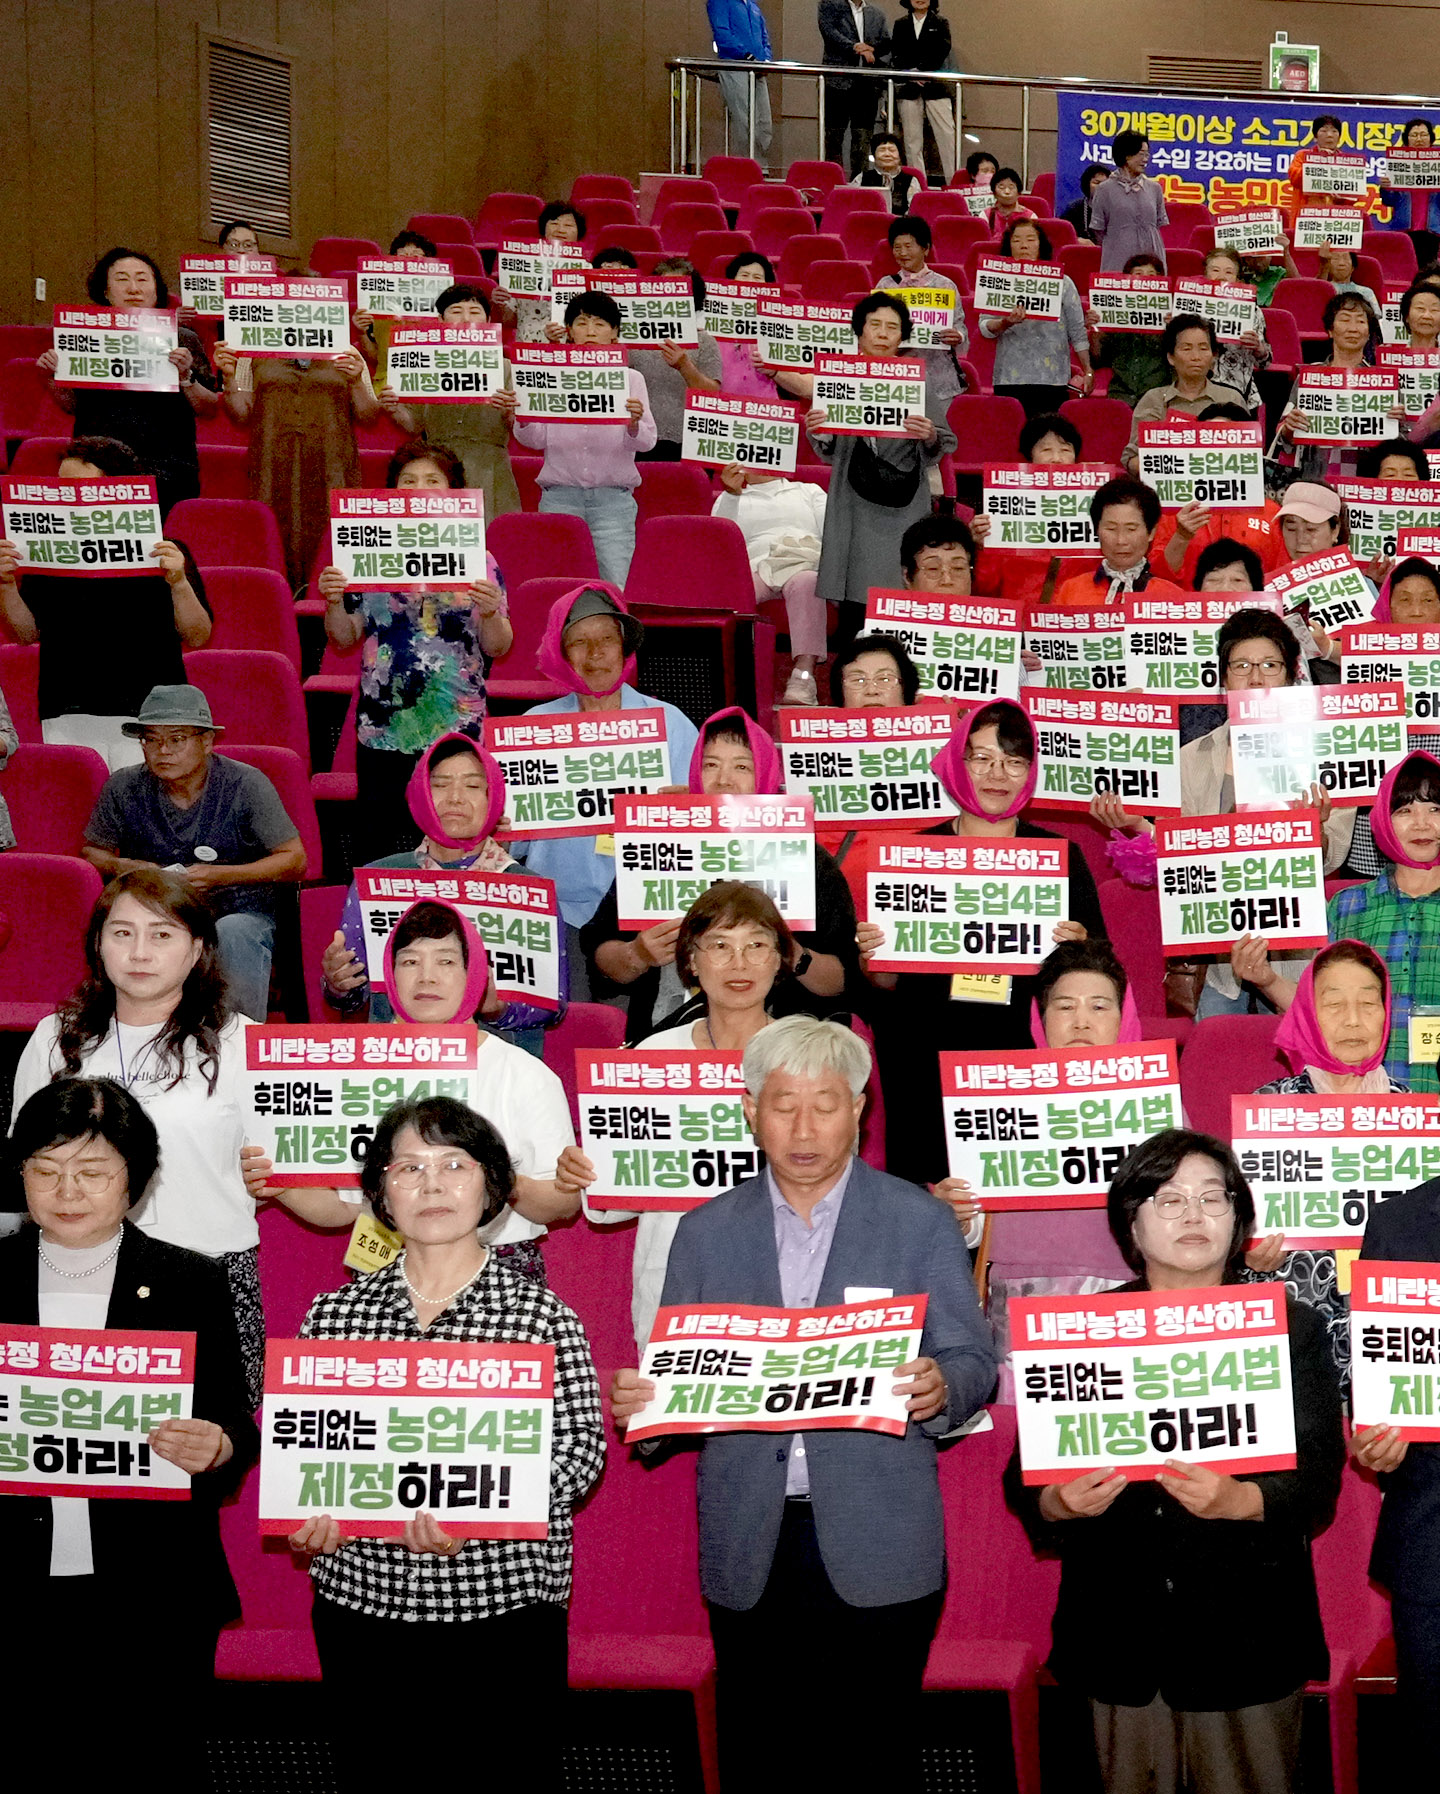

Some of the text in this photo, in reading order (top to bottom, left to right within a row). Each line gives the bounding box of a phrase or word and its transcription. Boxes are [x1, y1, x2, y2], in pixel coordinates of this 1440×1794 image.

[1289, 69, 1306, 78] AED
[1080, 109, 1236, 145] 30개월이상
[1152, 148, 1191, 170] 수입
[1194, 150, 1273, 173] 강요하는
[1395, 174, 1440, 187] 제정하라!
[230, 283, 344, 298] 내란농정 청산하고
[910, 292, 950, 306] 농업의 주체
[228, 304, 345, 325] 후퇴없는 농업4법
[241, 326, 334, 348] 제정하라!
[1143, 427, 1259, 445] 내란농정 청산하고
[1143, 452, 1259, 476] 후퇴없는 농업4법
[8, 484, 151, 502] 내란농정 청산하고
[1156, 478, 1246, 503] 제정하라!
[339, 497, 478, 515] 내란농정 청산하고
[8, 510, 156, 535] 후퇴없는 농업4법
[336, 523, 479, 548] 후퇴없는 농업4법
[27, 538, 144, 564] 제정하라!
[353, 552, 466, 578] 제정하라!
[878, 845, 1060, 871] 내란농정 청산하고
[874, 882, 1060, 916] 후퇴없는 농업4법
[895, 920, 1041, 954] 제정하라!
[357, 1232, 392, 1260] 조성애
[1026, 1300, 1276, 1341] 내란농정 청산하고
[283, 1356, 542, 1389] 내란농정 청산하고
[1024, 1347, 1281, 1404] 후퇴없는 농업4법
[272, 1407, 541, 1454] 후퇴없는 농업4법
[1055, 1404, 1258, 1457] 제정하라!
[299, 1461, 511, 1510] 제정하라!
